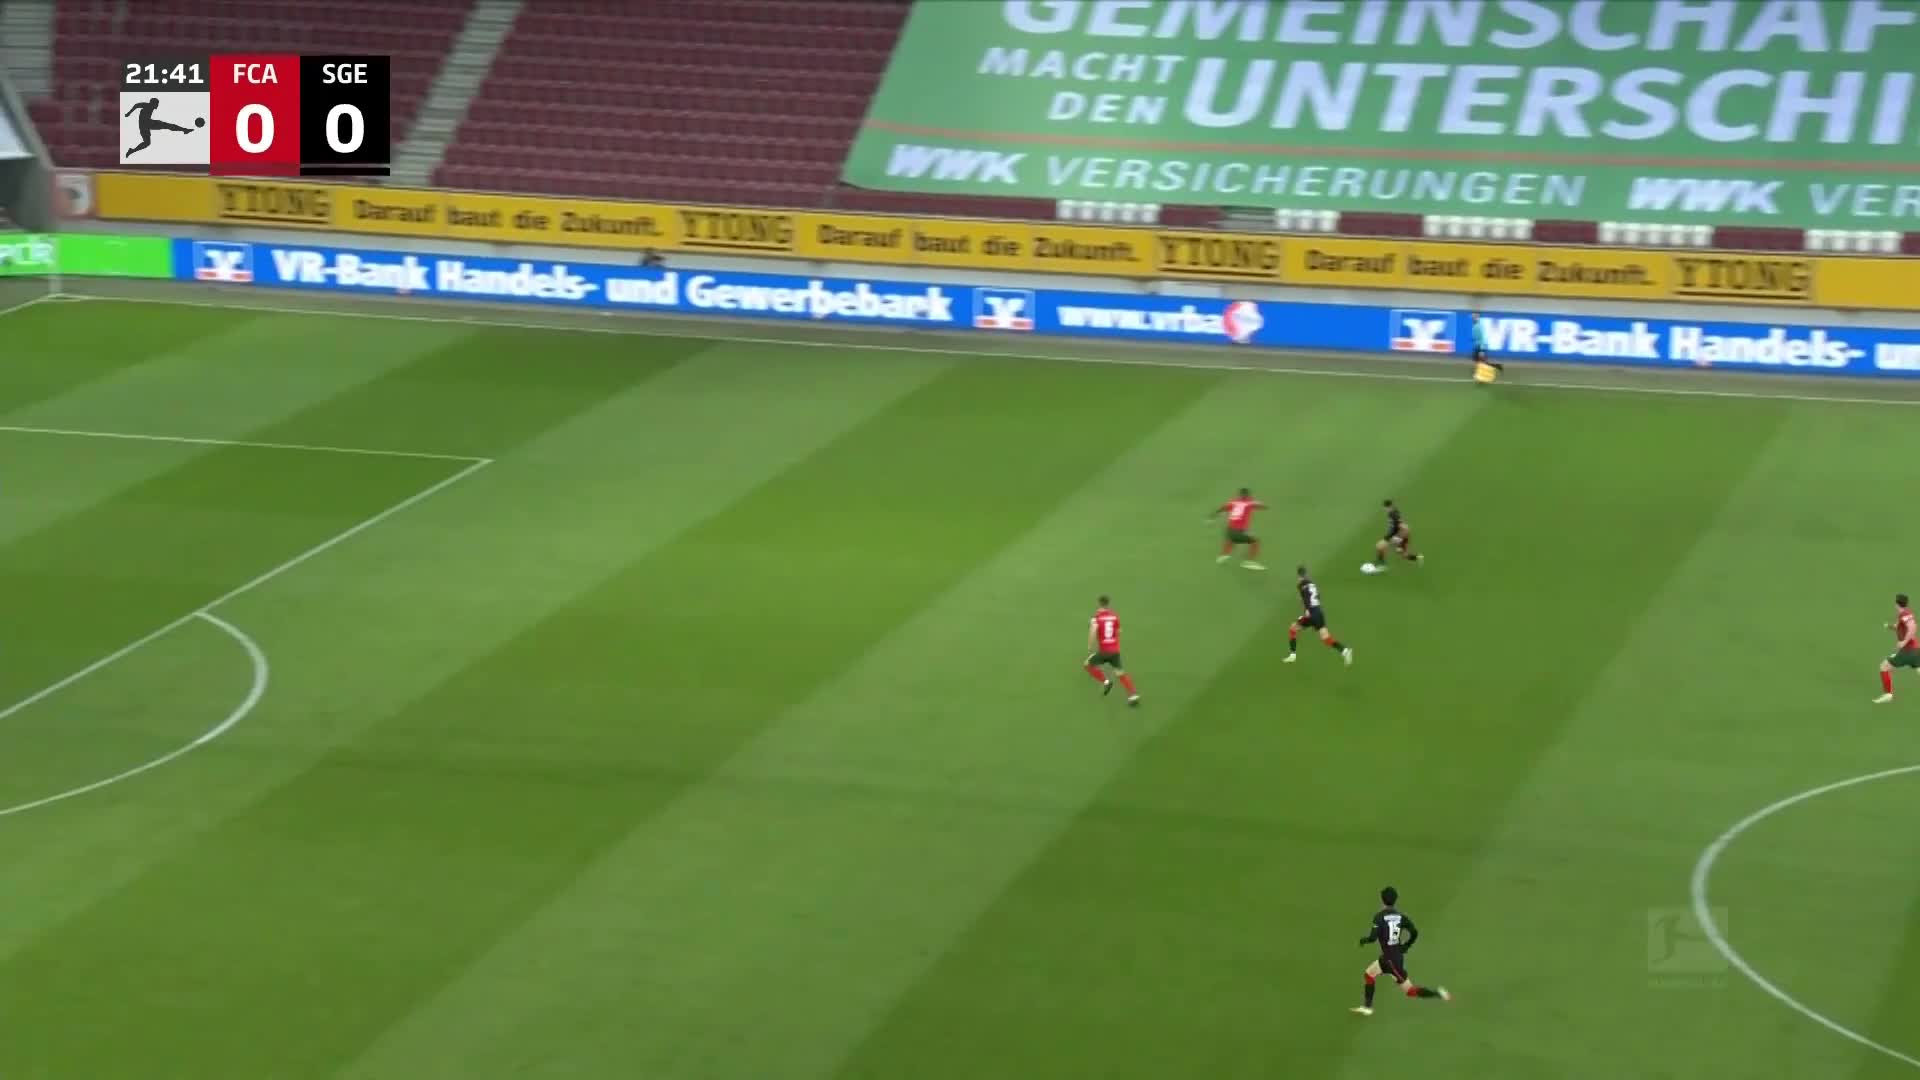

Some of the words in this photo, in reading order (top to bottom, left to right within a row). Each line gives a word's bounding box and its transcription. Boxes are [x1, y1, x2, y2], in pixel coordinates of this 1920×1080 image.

[978, 46, 1186, 84] MACHT
[1048, 92, 1169, 125] DEN
[1183, 57, 1914, 144] UNTERSCHI
[885, 144, 1028, 184] WWK
[1046, 155, 1586, 207] VERSICHERUNGEN
[218, 184, 330, 218] YTONG
[1626, 176, 1785, 214] WWK
[1808, 183, 1920, 218] VER
[353, 199, 436, 224] Darauf
[446, 204, 504, 228] baut
[513, 209, 550, 231] die
[560, 211, 664, 237] Zukunft.
[678, 209, 795, 245] YTONG
[817, 223, 904, 249] Darauf
[915, 233, 971, 254] baut
[982, 235, 1021, 257] die
[1033, 236, 1141, 263] Zukunft.
[1158, 236, 1280, 271] YTONG
[271, 249, 431, 291] VR-Bank
[435, 258, 598, 301] Handels-
[606, 271, 678, 306] und
[686, 275, 954, 323] Gewerbebank
[1304, 249, 1397, 274] Darauf
[1408, 254, 1470, 278] baut
[1481, 260, 1522, 281] die
[1536, 260, 1657, 286] Zukunft.
[1673, 257, 1812, 293] YTONG
[1480, 317, 1660, 361] VR-Bank
[1669, 326, 1866, 369] Handels-
